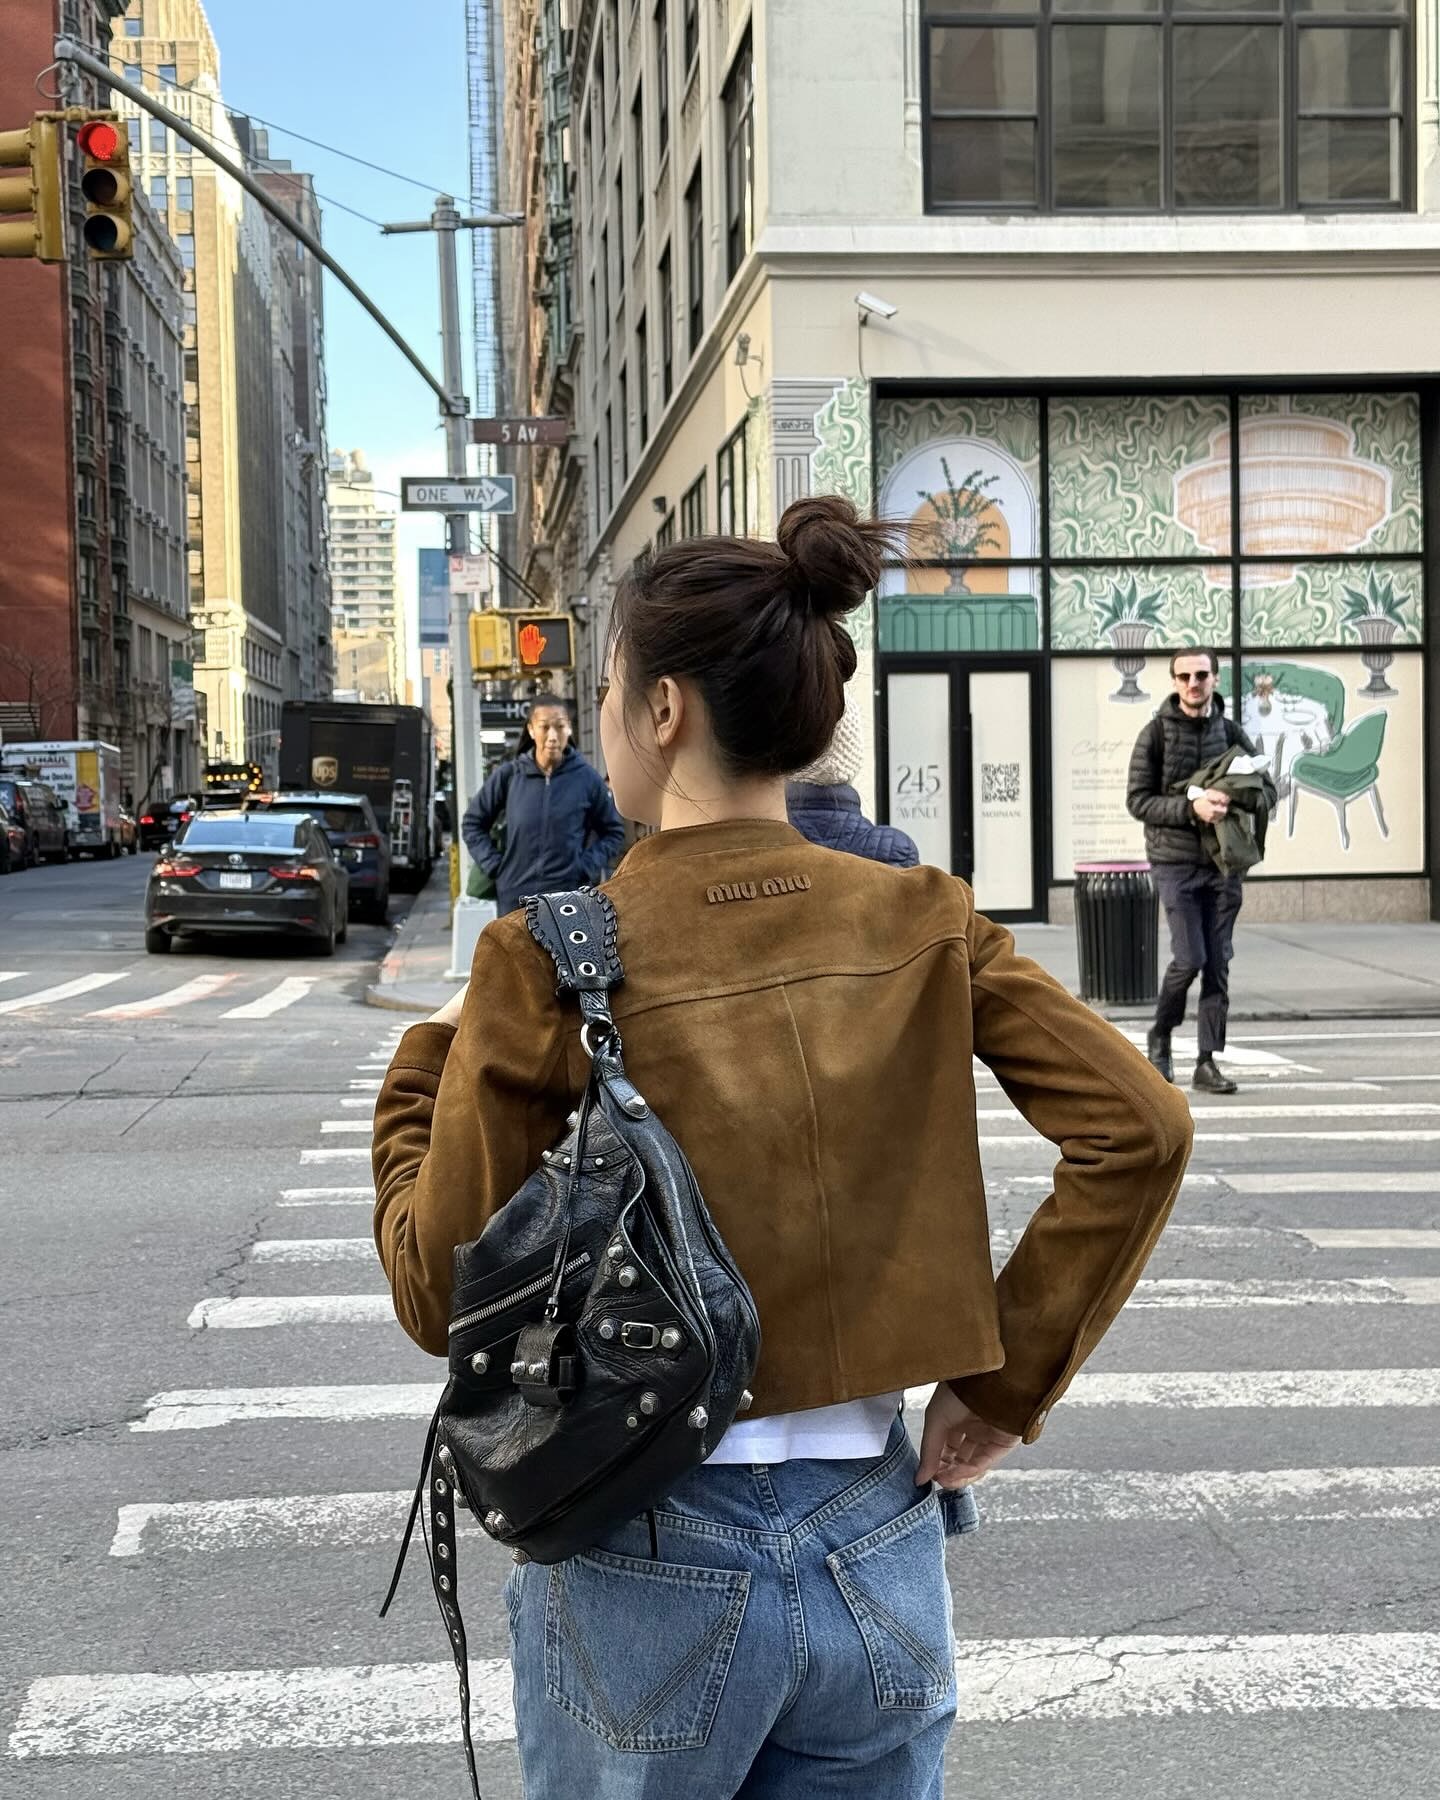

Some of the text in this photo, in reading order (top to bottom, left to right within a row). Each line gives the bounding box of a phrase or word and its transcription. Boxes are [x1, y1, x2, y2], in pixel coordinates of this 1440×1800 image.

[501, 425, 510, 442] 5
[416, 487, 497, 502] ONE WAY
[314, 766, 336, 782] ups
[896, 764, 941, 797] 245
